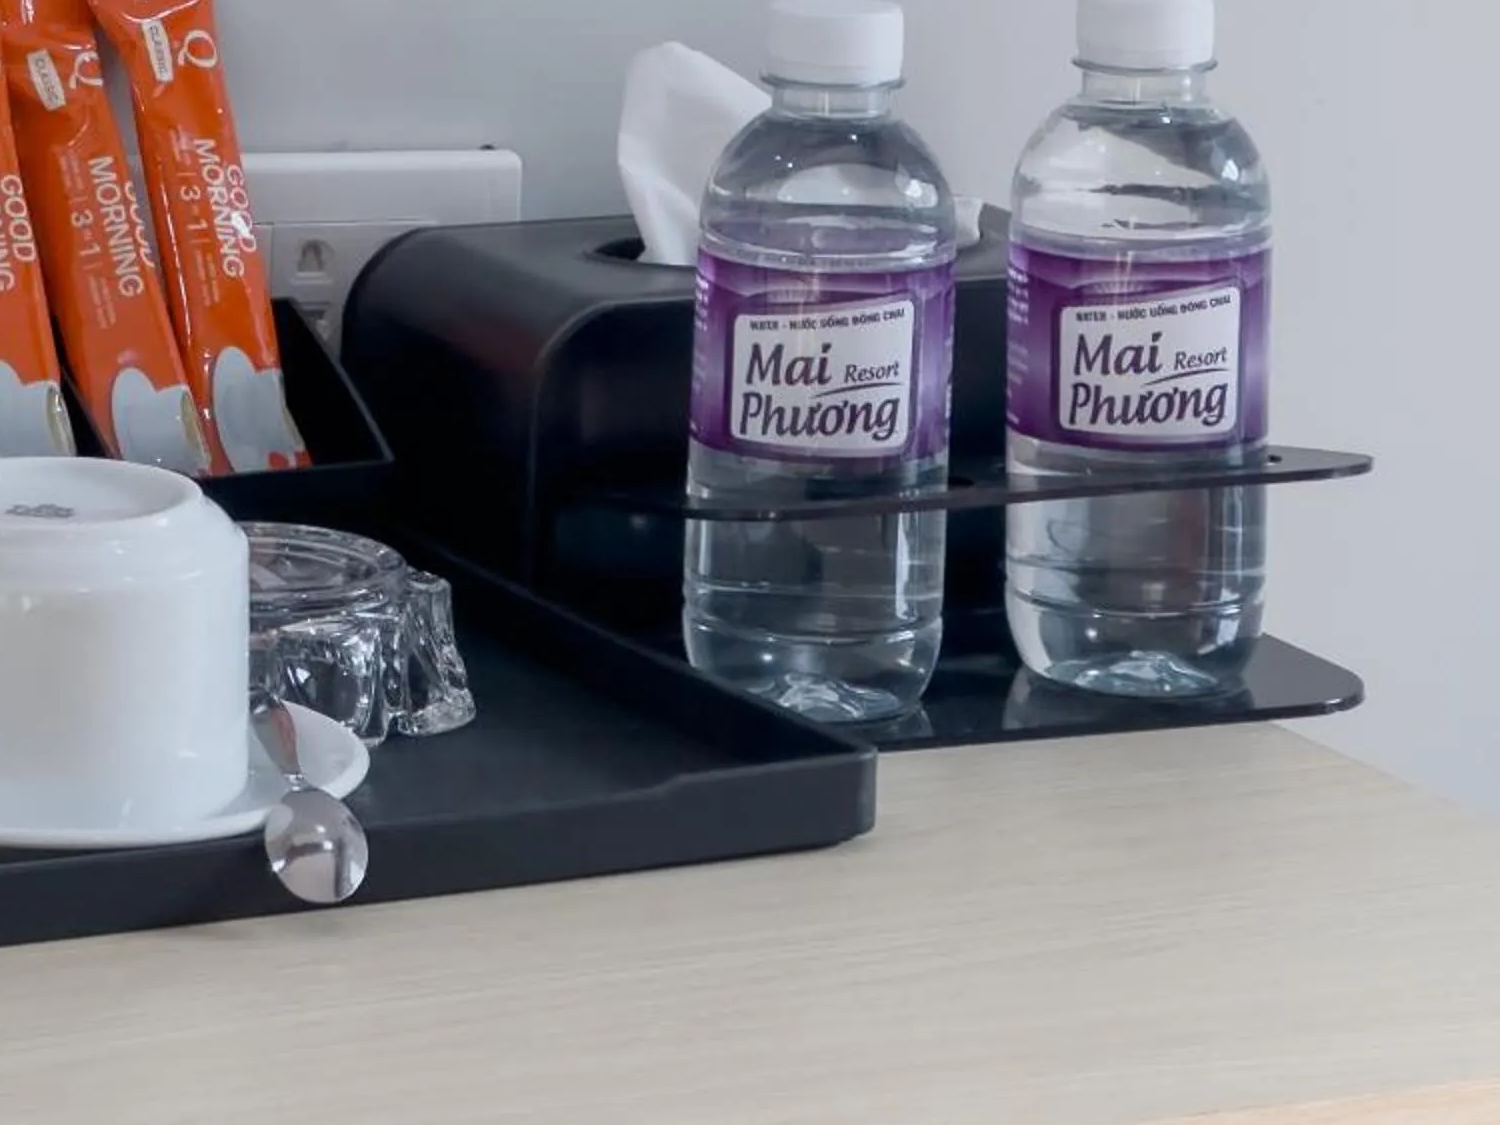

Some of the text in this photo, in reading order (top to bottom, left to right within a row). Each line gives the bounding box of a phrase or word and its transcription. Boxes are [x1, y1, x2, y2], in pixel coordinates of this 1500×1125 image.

[180, 186, 201, 202] 3
[194, 138, 245, 278] MORNING
[0, 174, 37, 263] GOOD
[70, 209, 94, 227] 3
[88, 155, 145, 298] MORNING
[79, 242, 101, 257] 1
[746, 342, 900, 386] Mai Resort
[1073, 331, 1228, 376] Mai Resort
[739, 392, 900, 441] Phương
[1068, 381, 1228, 427] Phương
